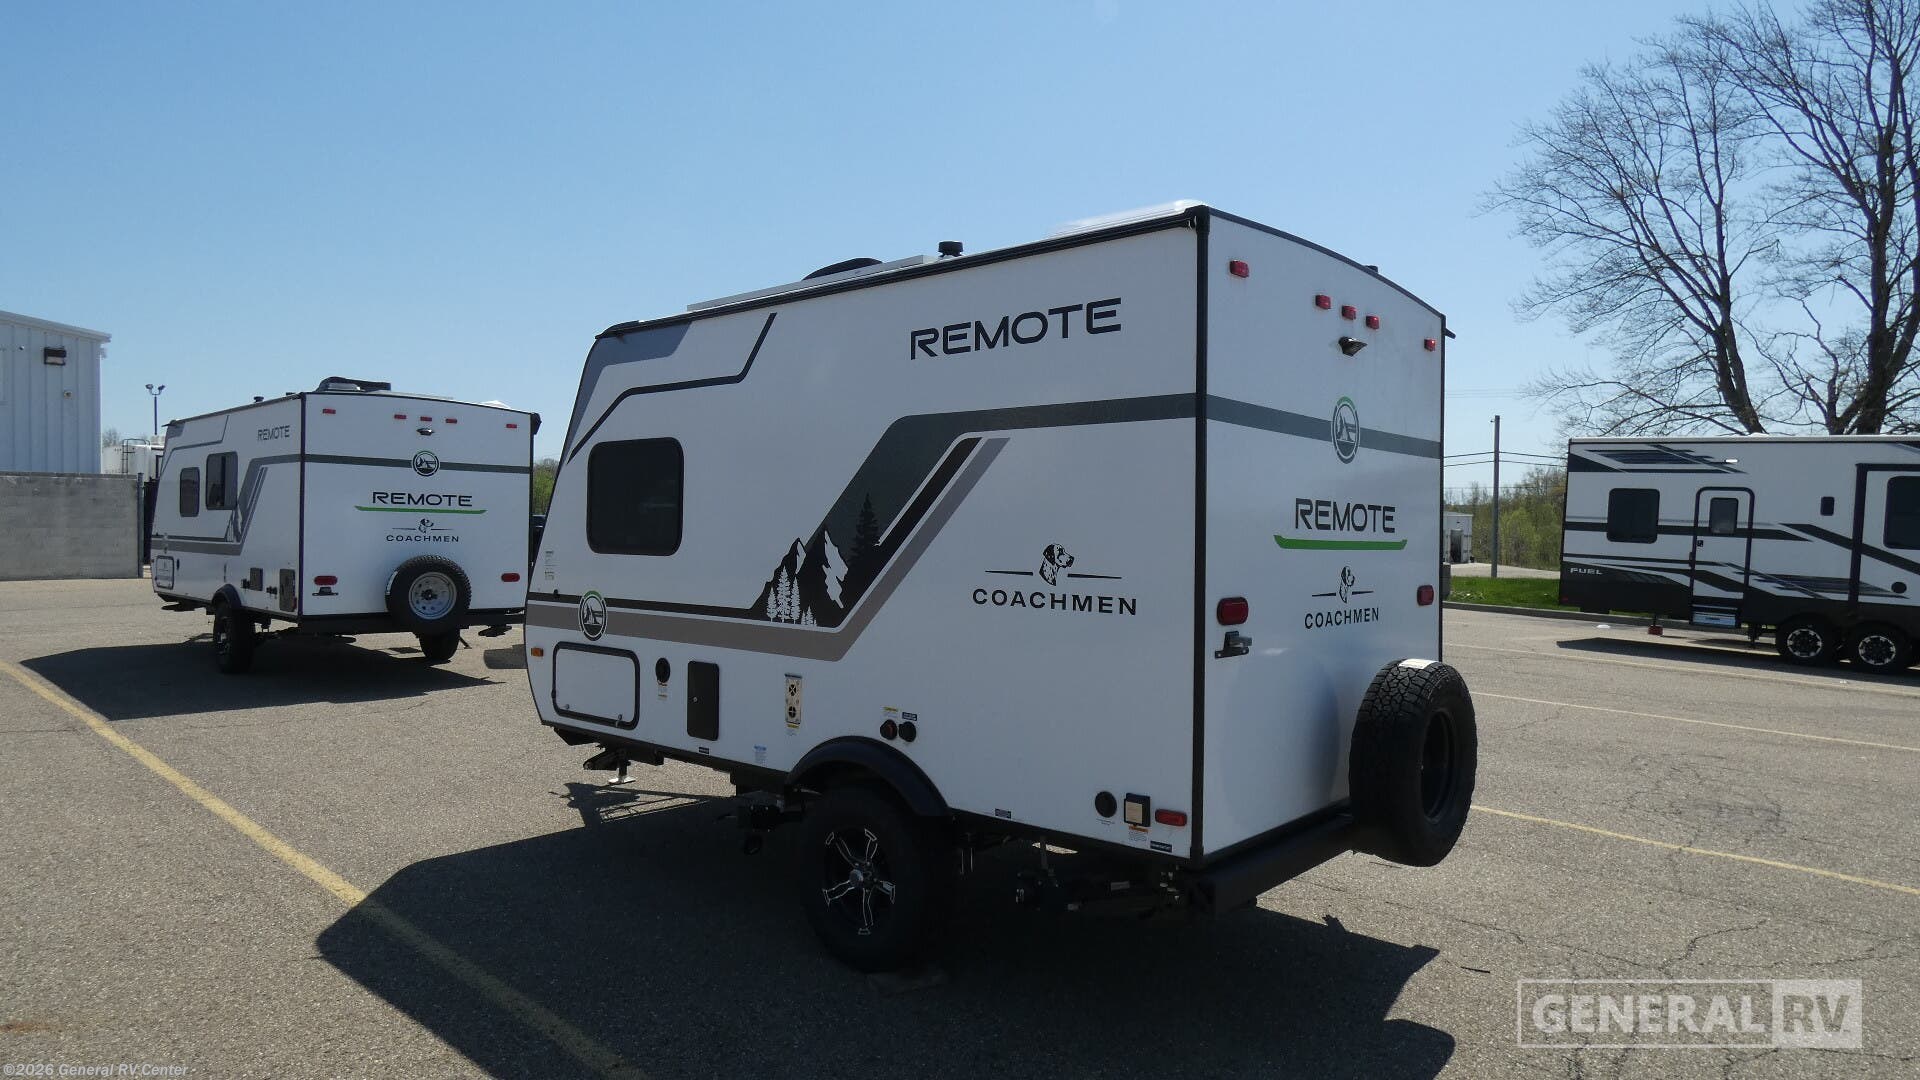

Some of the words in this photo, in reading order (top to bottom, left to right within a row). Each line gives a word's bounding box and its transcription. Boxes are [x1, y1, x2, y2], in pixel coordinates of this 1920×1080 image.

[911, 297, 1122, 361] REMOTE
[257, 424, 291, 441] REMOTE
[372, 491, 473, 507] REMOTE
[1294, 497, 1396, 534] REMOTE
[386, 534, 460, 543] COACHMEN
[1570, 567, 1604, 575] FUEL
[972, 588, 1137, 616] COACHMEN
[1304, 607, 1380, 630] COACHMEN
